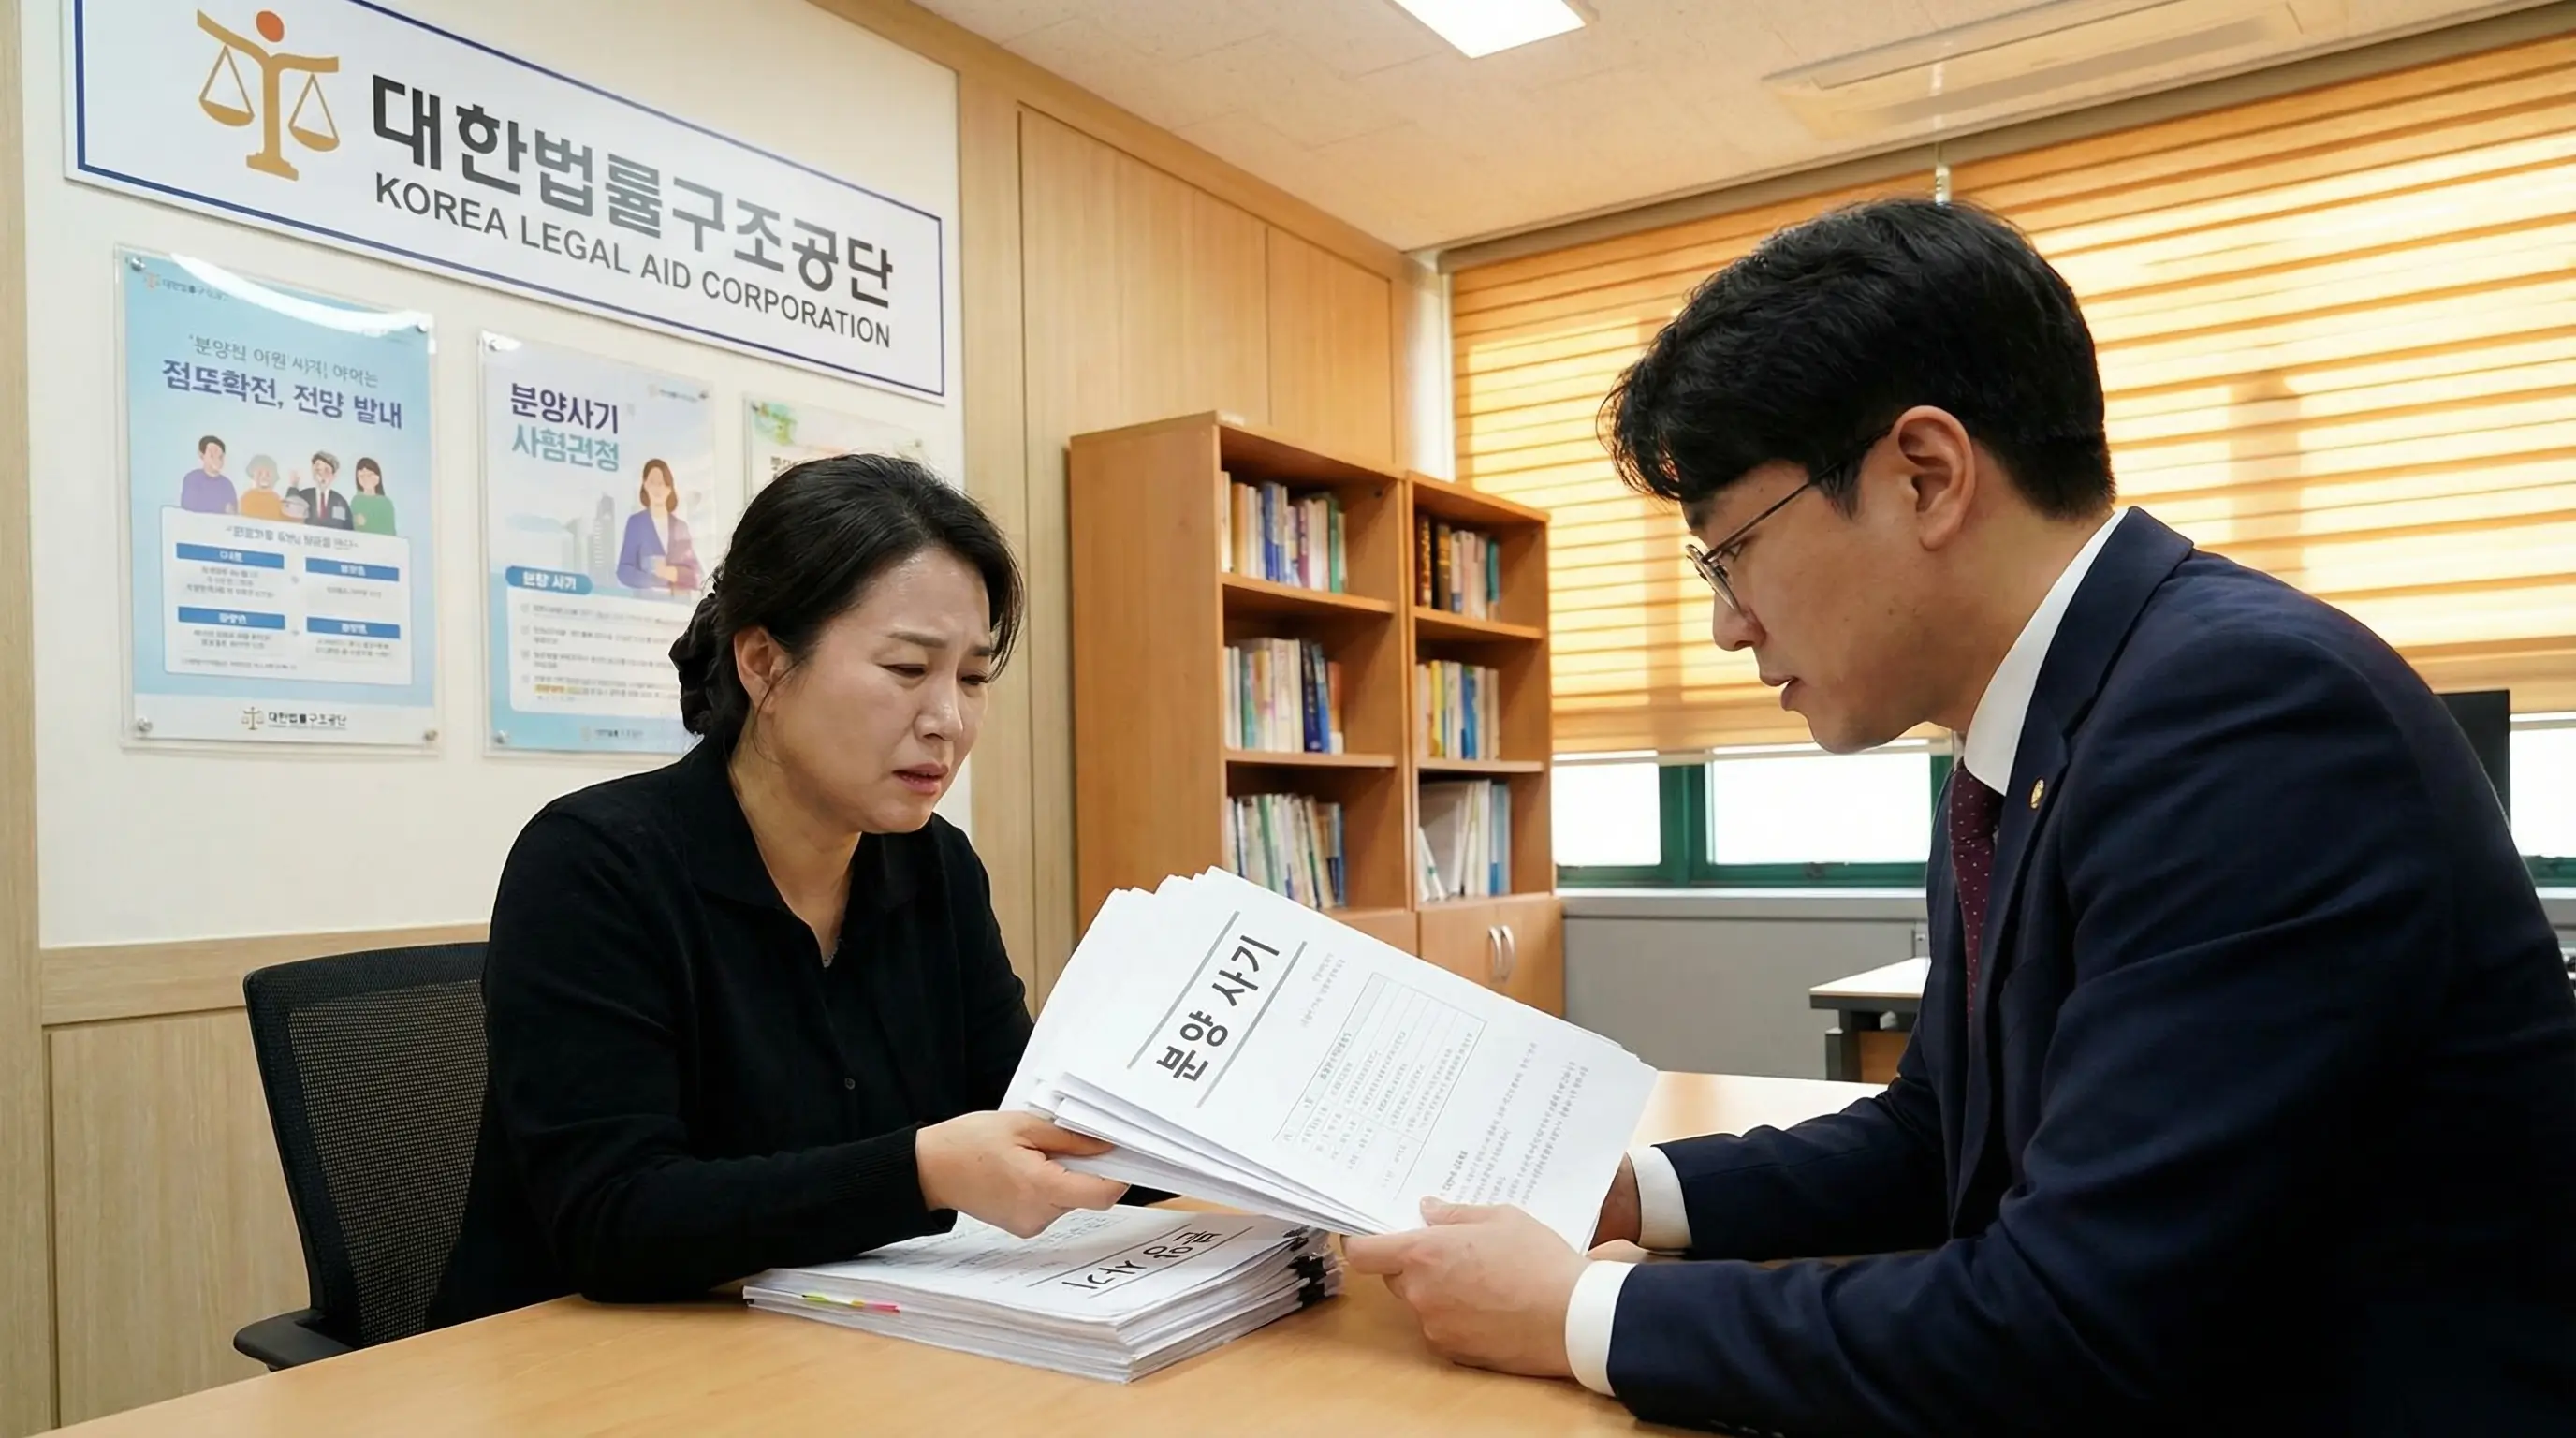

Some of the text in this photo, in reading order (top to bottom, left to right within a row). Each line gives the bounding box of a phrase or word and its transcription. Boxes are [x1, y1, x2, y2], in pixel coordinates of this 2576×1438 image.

[373, 74, 893, 308] 대한법률구조공단
[376, 172, 890, 348] KOREA LEGAL AID CORPORATION
[510, 382, 618, 434] 분양사기
[1156, 935, 1280, 1082] 분양 사기
[1061, 1260, 1148, 1289] 사기
